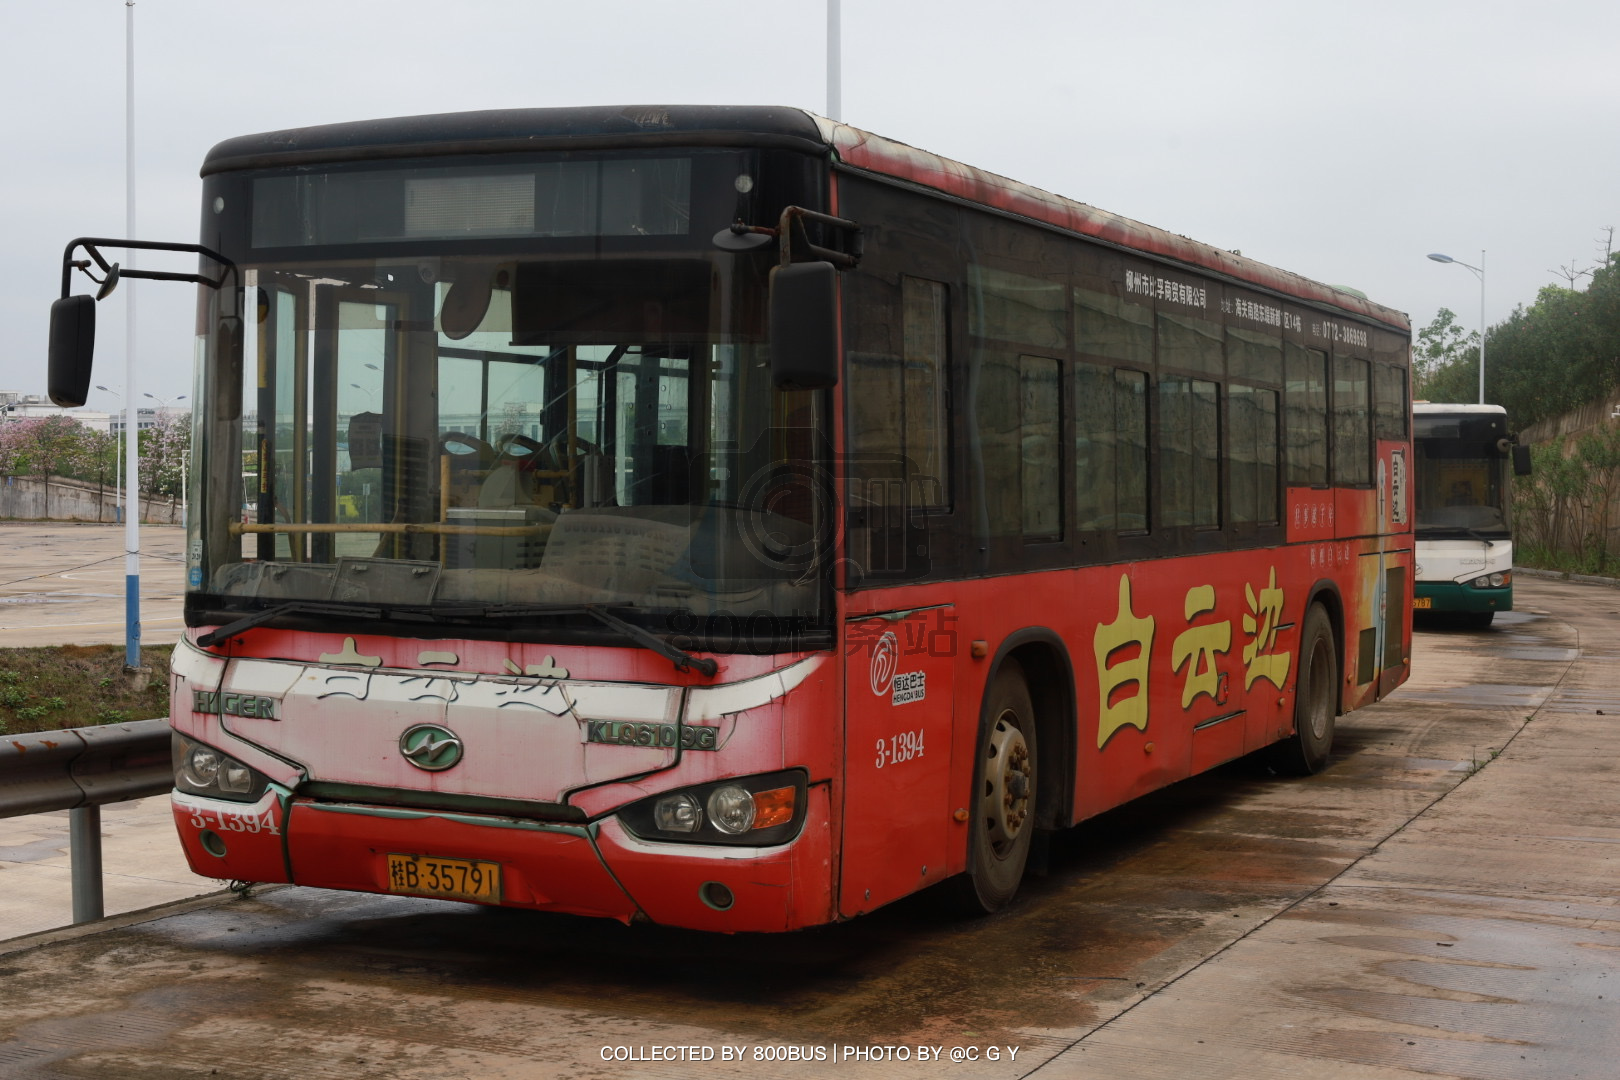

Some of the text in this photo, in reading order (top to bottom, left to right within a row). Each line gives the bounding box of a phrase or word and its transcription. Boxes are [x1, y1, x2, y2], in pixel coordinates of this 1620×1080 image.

[1093, 565, 1291, 749] 白云边
[893, 688, 925, 703] HENGDA BUS
[894, 673, 925, 693] 恒达巴士
[193, 691, 274, 718] HIGER
[588, 720, 715, 748] KLQ6109G
[875, 728, 925, 768] 3-1394
[189, 803, 281, 836] 3-1394
